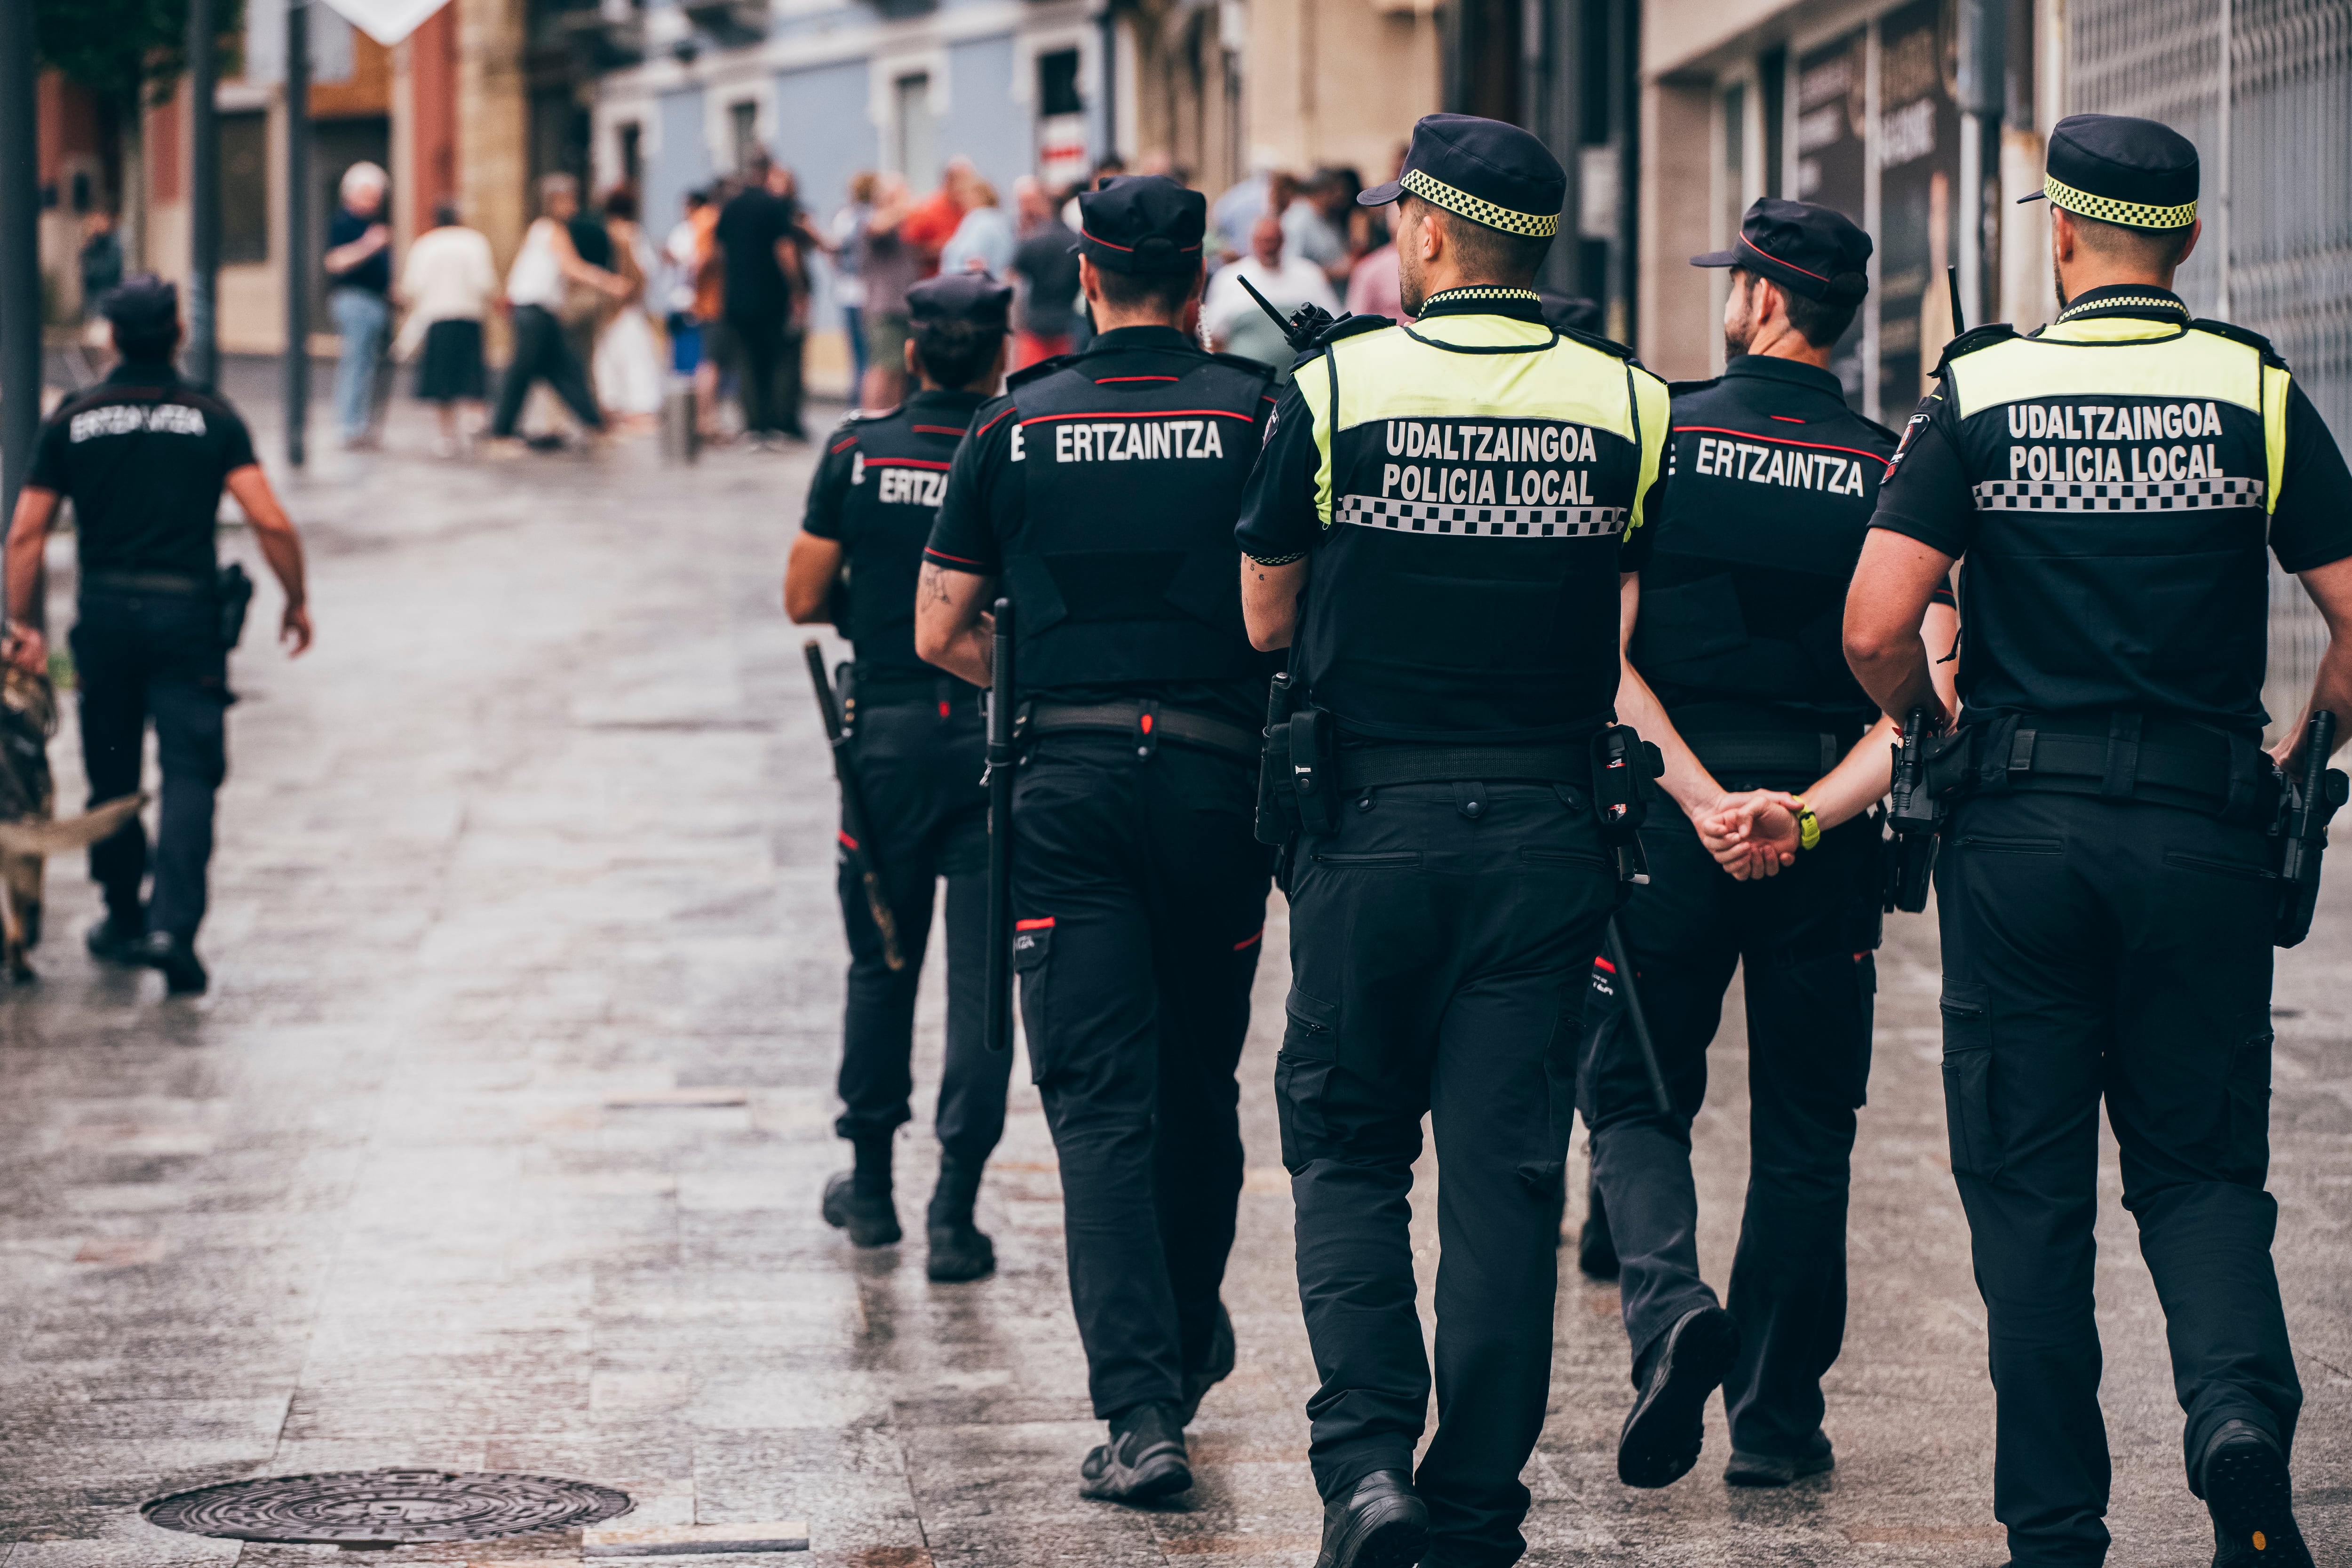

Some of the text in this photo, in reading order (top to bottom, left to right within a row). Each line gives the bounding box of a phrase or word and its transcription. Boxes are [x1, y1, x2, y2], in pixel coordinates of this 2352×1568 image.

[1056, 421, 1223, 463] ERTZAINTZA
[1386, 420, 1597, 462] UDALTZAINGOA
[2008, 402, 2223, 440] UDALTZAINGOA
[1695, 437, 1864, 497] ERTZAINTZA
[2010, 443, 2223, 483] POLICIA LOCAL
[1382, 463, 1594, 506] POLICIA LOCAL
